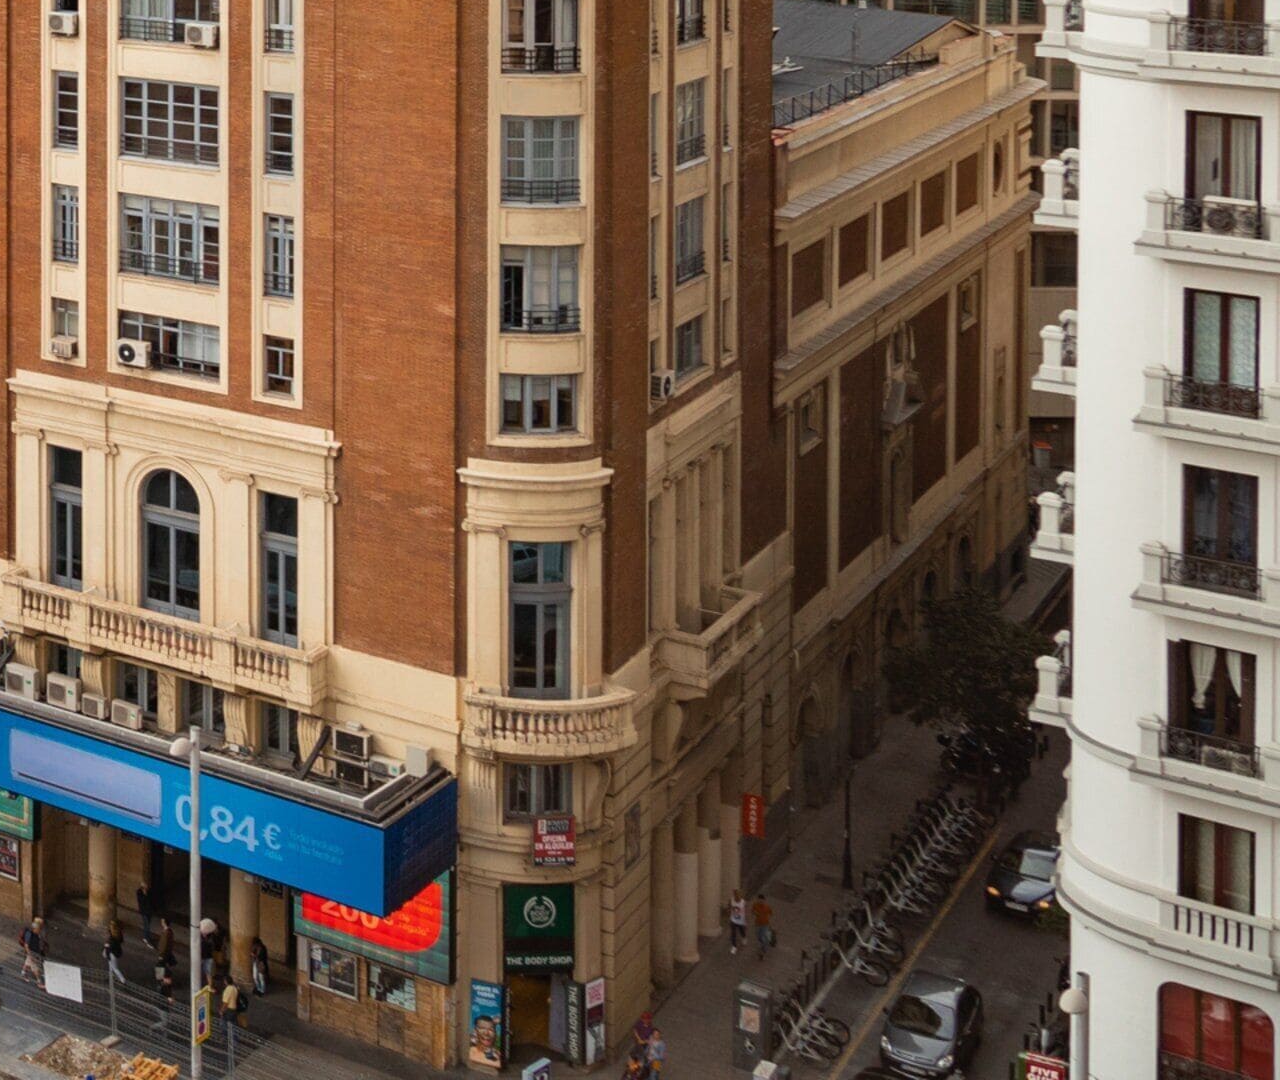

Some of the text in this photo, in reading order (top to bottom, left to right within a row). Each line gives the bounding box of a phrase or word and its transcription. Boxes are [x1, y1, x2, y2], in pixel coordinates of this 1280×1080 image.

[545, 841, 574, 850] ALQUILER
[506, 955, 573, 966] THE BODY SHOP
[567, 985, 579, 1059] THE BODY SHOP
[1030, 1064, 1060, 1079] FIVE
